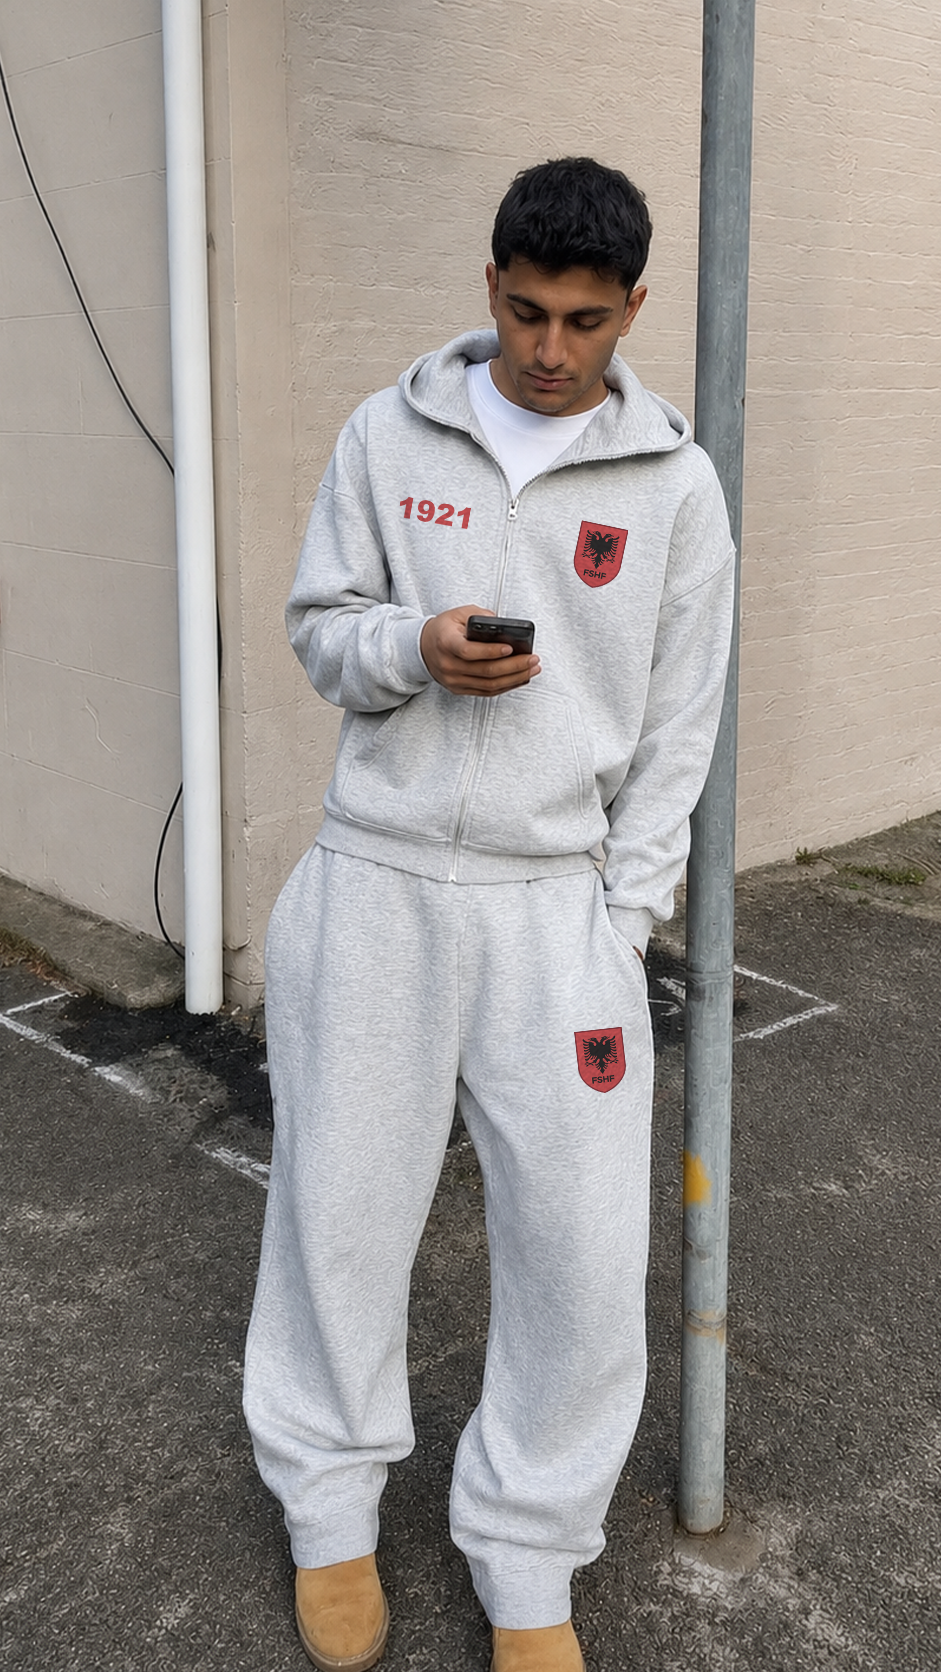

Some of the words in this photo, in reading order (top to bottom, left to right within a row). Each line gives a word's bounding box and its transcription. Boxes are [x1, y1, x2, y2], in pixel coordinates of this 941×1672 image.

[399, 496, 472, 530] 1921
[583, 569, 607, 579] FSHF
[591, 1074, 615, 1084] FSHF
